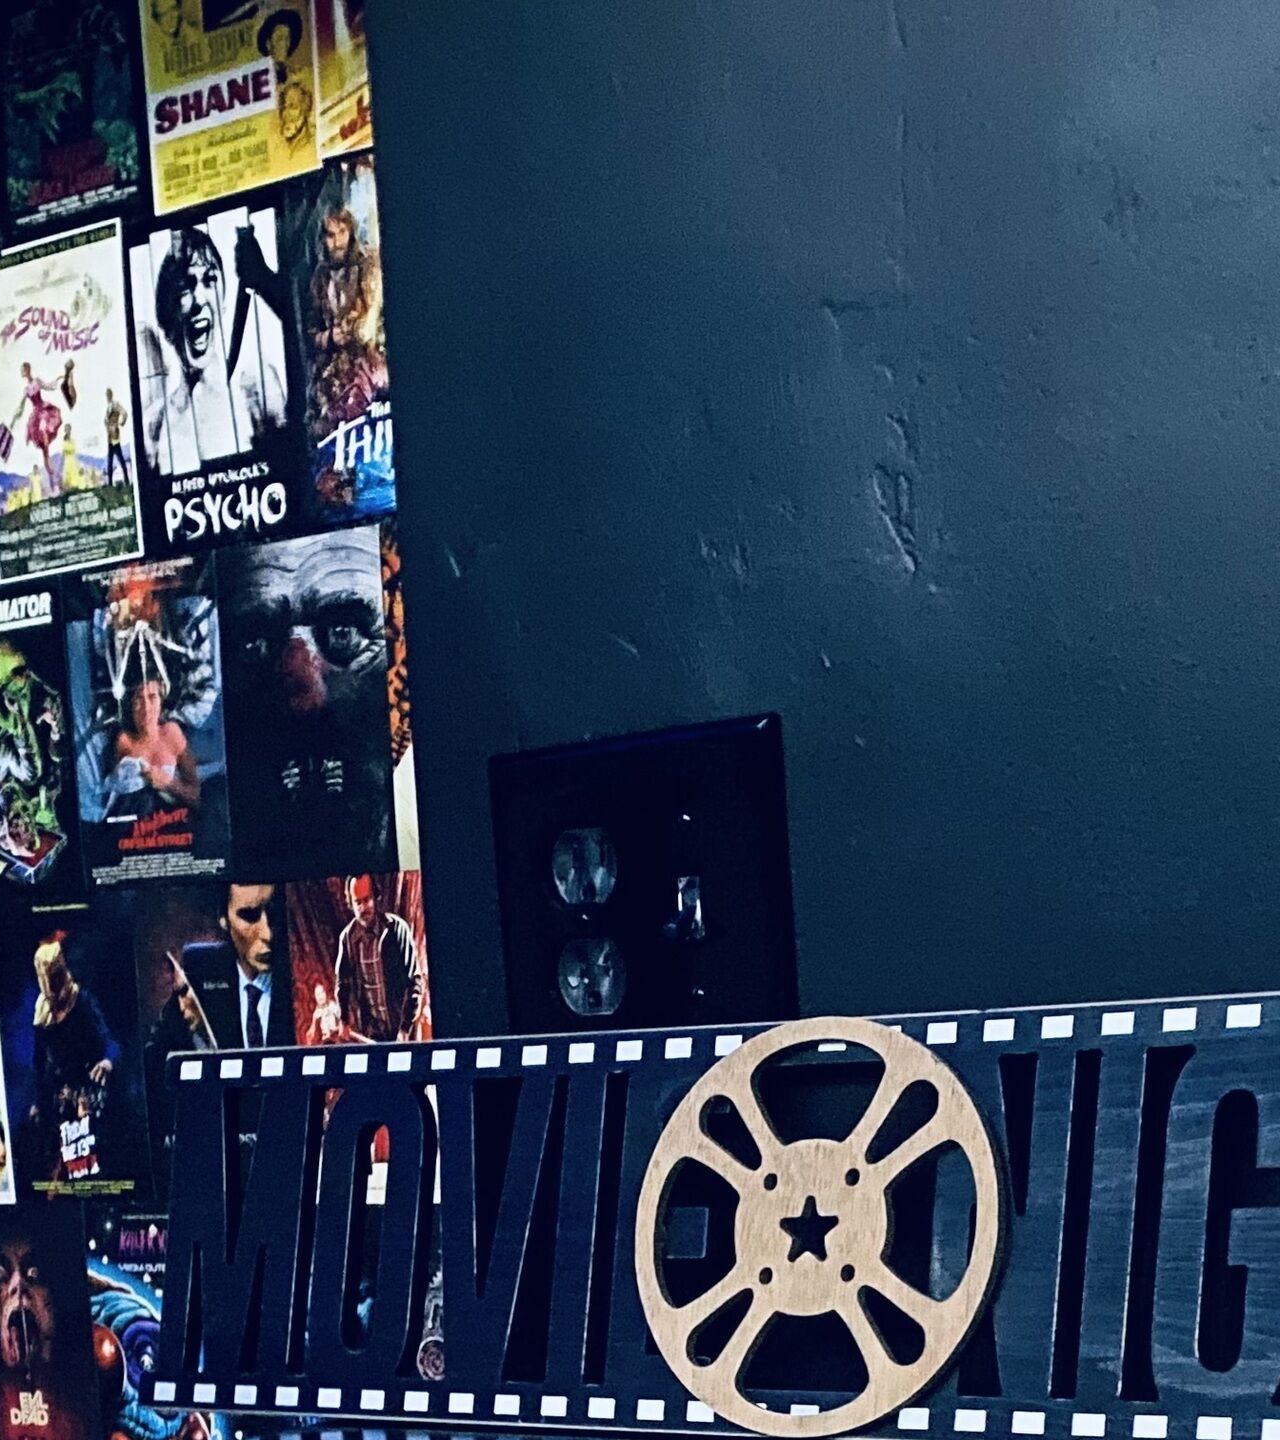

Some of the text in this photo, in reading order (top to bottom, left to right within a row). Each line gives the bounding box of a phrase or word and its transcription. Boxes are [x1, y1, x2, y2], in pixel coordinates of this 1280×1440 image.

[154, 68, 271, 134] SHANE
[15, 306, 70, 340] SOUND
[46, 321, 99, 355] MUSIC
[164, 482, 287, 543] PSYCHO
[10, 1406, 49, 1427] DEAD
